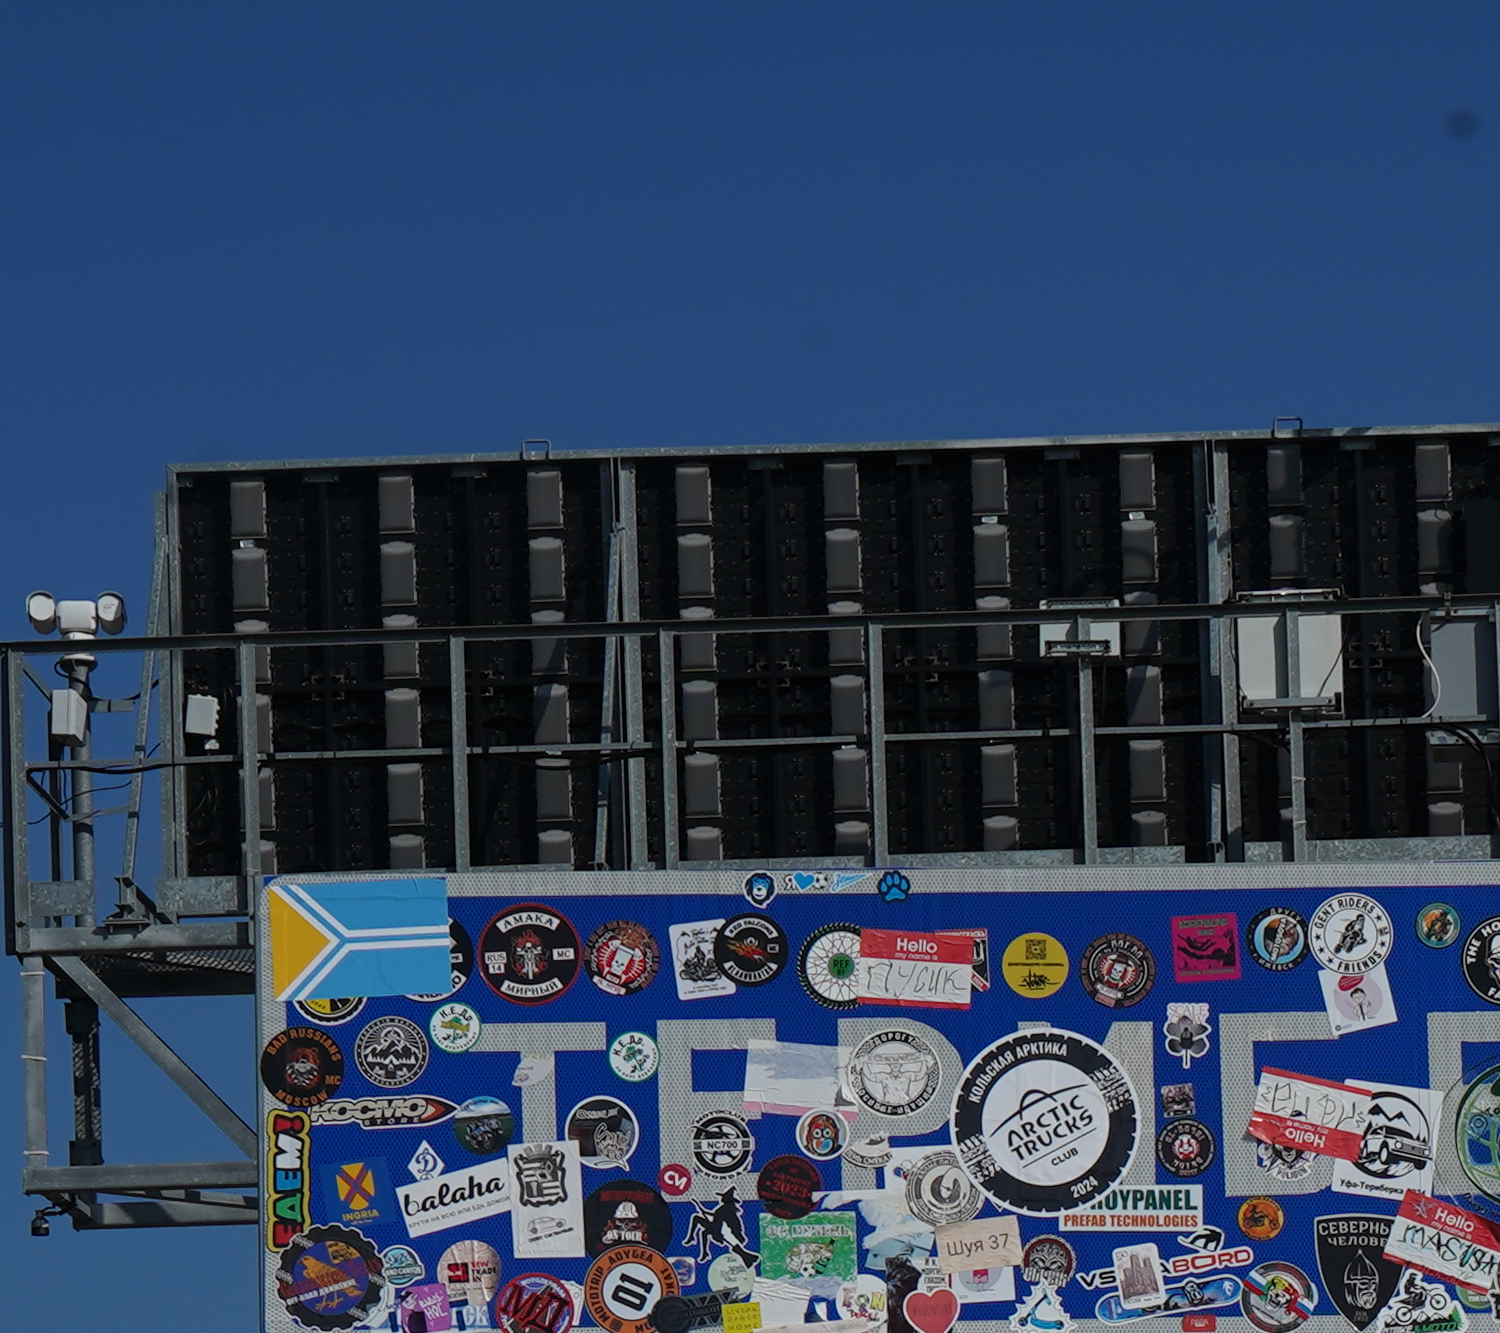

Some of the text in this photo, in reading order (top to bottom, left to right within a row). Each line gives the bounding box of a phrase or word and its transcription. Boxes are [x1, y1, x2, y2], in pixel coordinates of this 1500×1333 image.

[503, 913, 554, 929] АМАКА
[1316, 899, 1375, 929] GENT RIDERS
[896, 938, 937, 954] Hello
[1467, 940, 1482, 965] THE
[486, 953, 505, 962] RUS
[894, 953, 909, 961] my
[1338, 950, 1382, 972] FRIENDS
[506, 980, 558, 996] МИРНЫЙ
[288, 1027, 341, 1062] RUSSIANS
[325, 1075, 341, 1085] MC
[968, 1040, 1068, 1104] КОЛЬСКАЯ АРКТИКА
[275, 1089, 329, 1107] MOSCOW
[364, 1117, 420, 1126] STORE
[1007, 1095, 1085, 1147] ARCTIC
[707, 1140, 738, 1150] NC700
[1011, 1111, 1093, 1161] TRUCKS
[1285, 1127, 1326, 1148] Hello
[1051, 1147, 1079, 1166] CLUB
[699, 1170, 742, 1180] HONDA
[404, 1175, 505, 1216] balaha
[1070, 1175, 1099, 1199] 2024
[342, 1209, 380, 1222] INGRIA
[1064, 1214, 1198, 1228] PREFAB TECHNOLOGIES
[1434, 1207, 1475, 1233] Hello
[1430, 1220, 1466, 1238] my name
[946, 1233, 1009, 1257] Шуя 37
